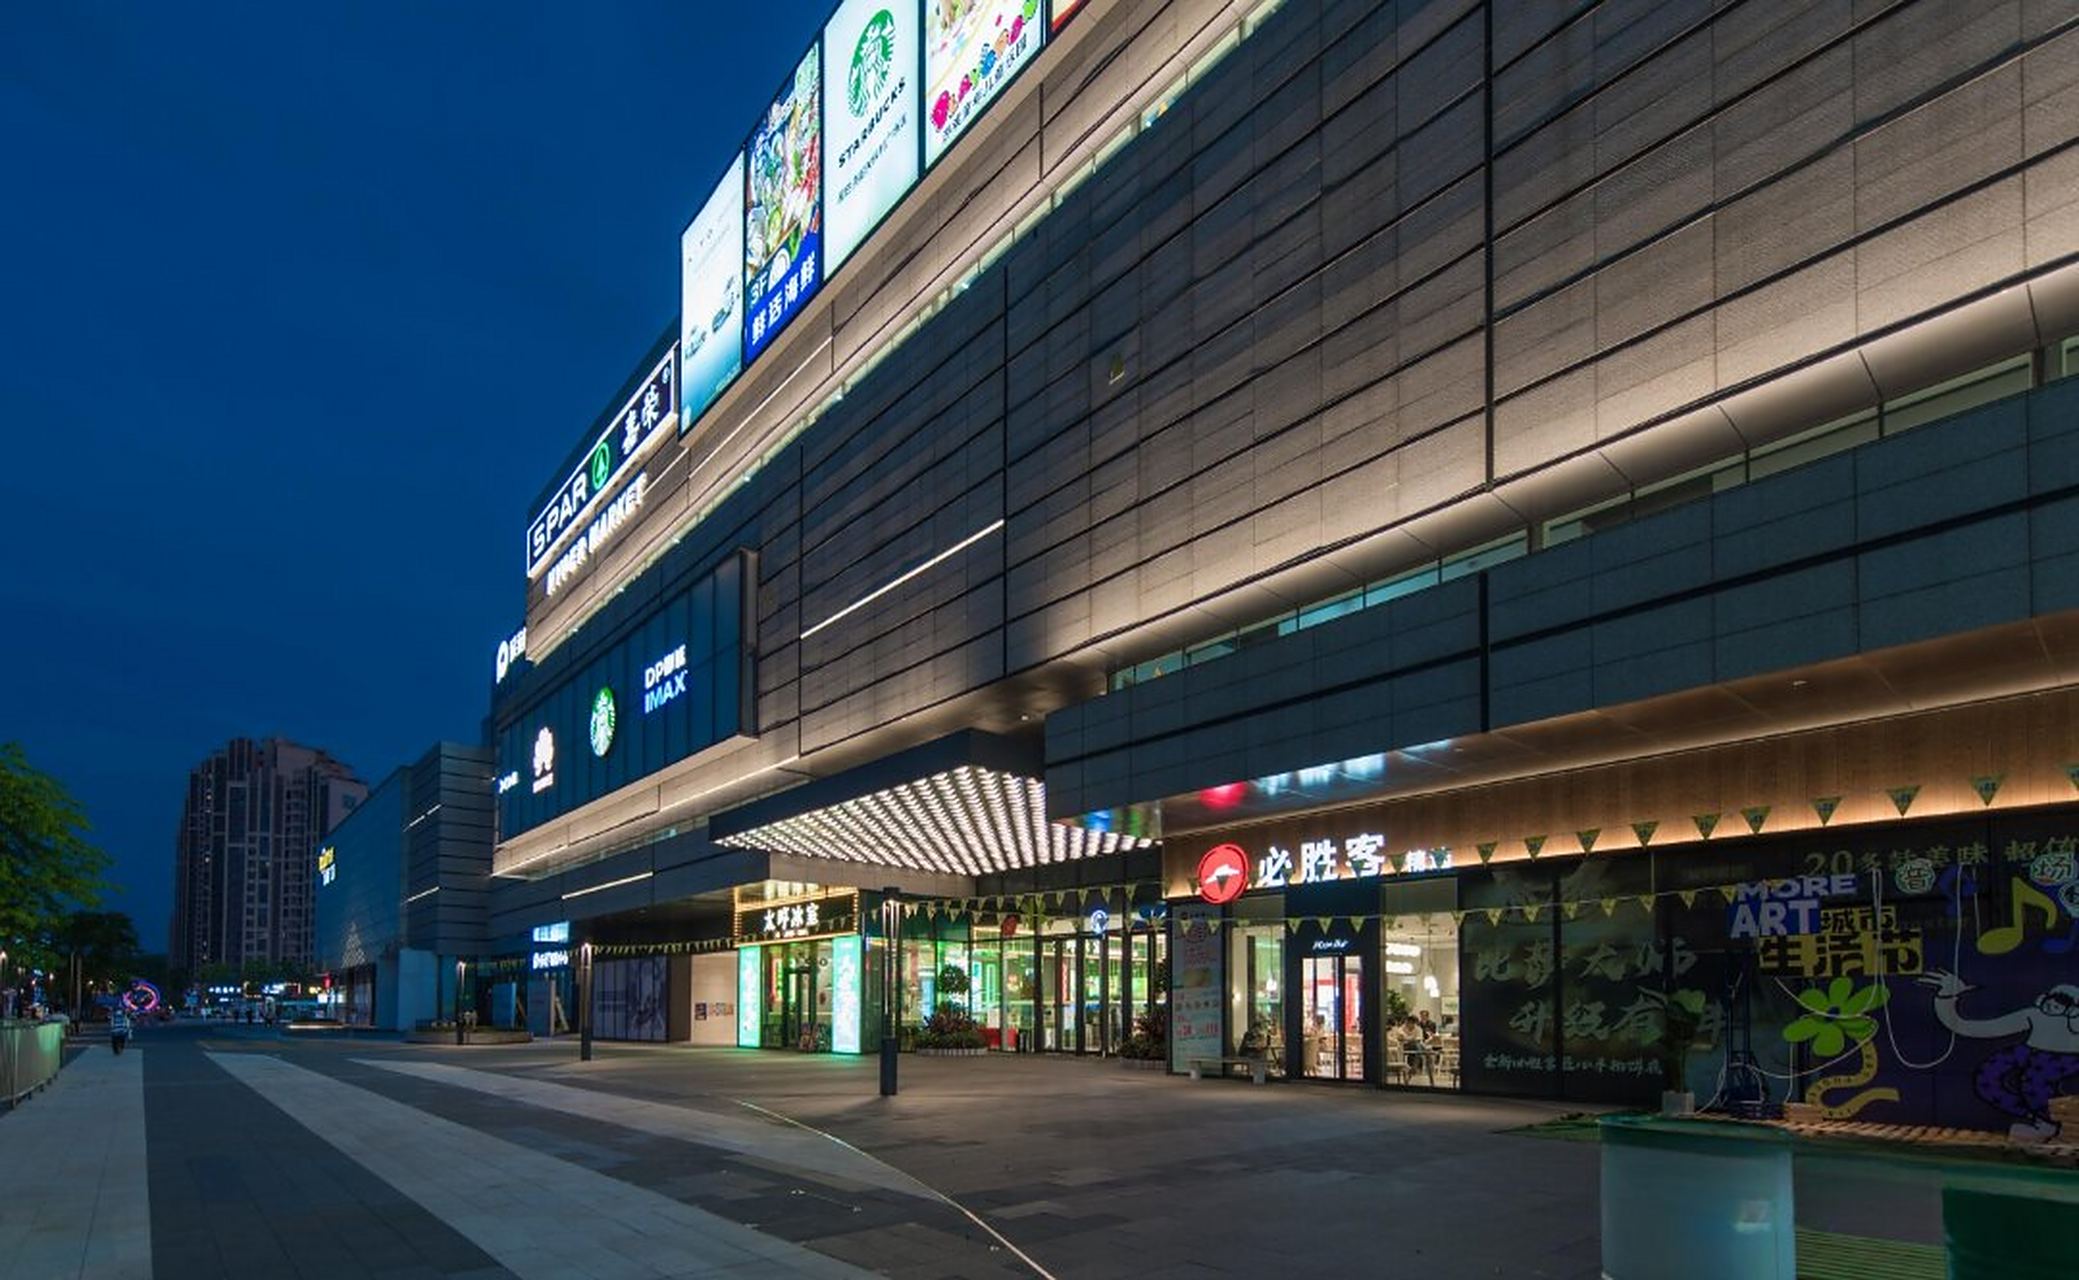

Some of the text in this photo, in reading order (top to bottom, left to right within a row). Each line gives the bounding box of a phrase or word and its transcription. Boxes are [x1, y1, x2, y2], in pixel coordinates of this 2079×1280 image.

[838, 76, 906, 168] STARBUCKS
[752, 250, 815, 346] 鲜活海鲜
[622, 384, 659, 455] 嘉荣
[532, 473, 588, 557] SPAR
[588, 471, 648, 554] MARKET
[644, 672, 686, 714] IMAX
[1257, 834, 1385, 888] 必胜客
[1735, 873, 1857, 900] MORE
[1731, 899, 1820, 939] ART
[1820, 905, 1897, 934] 城市
